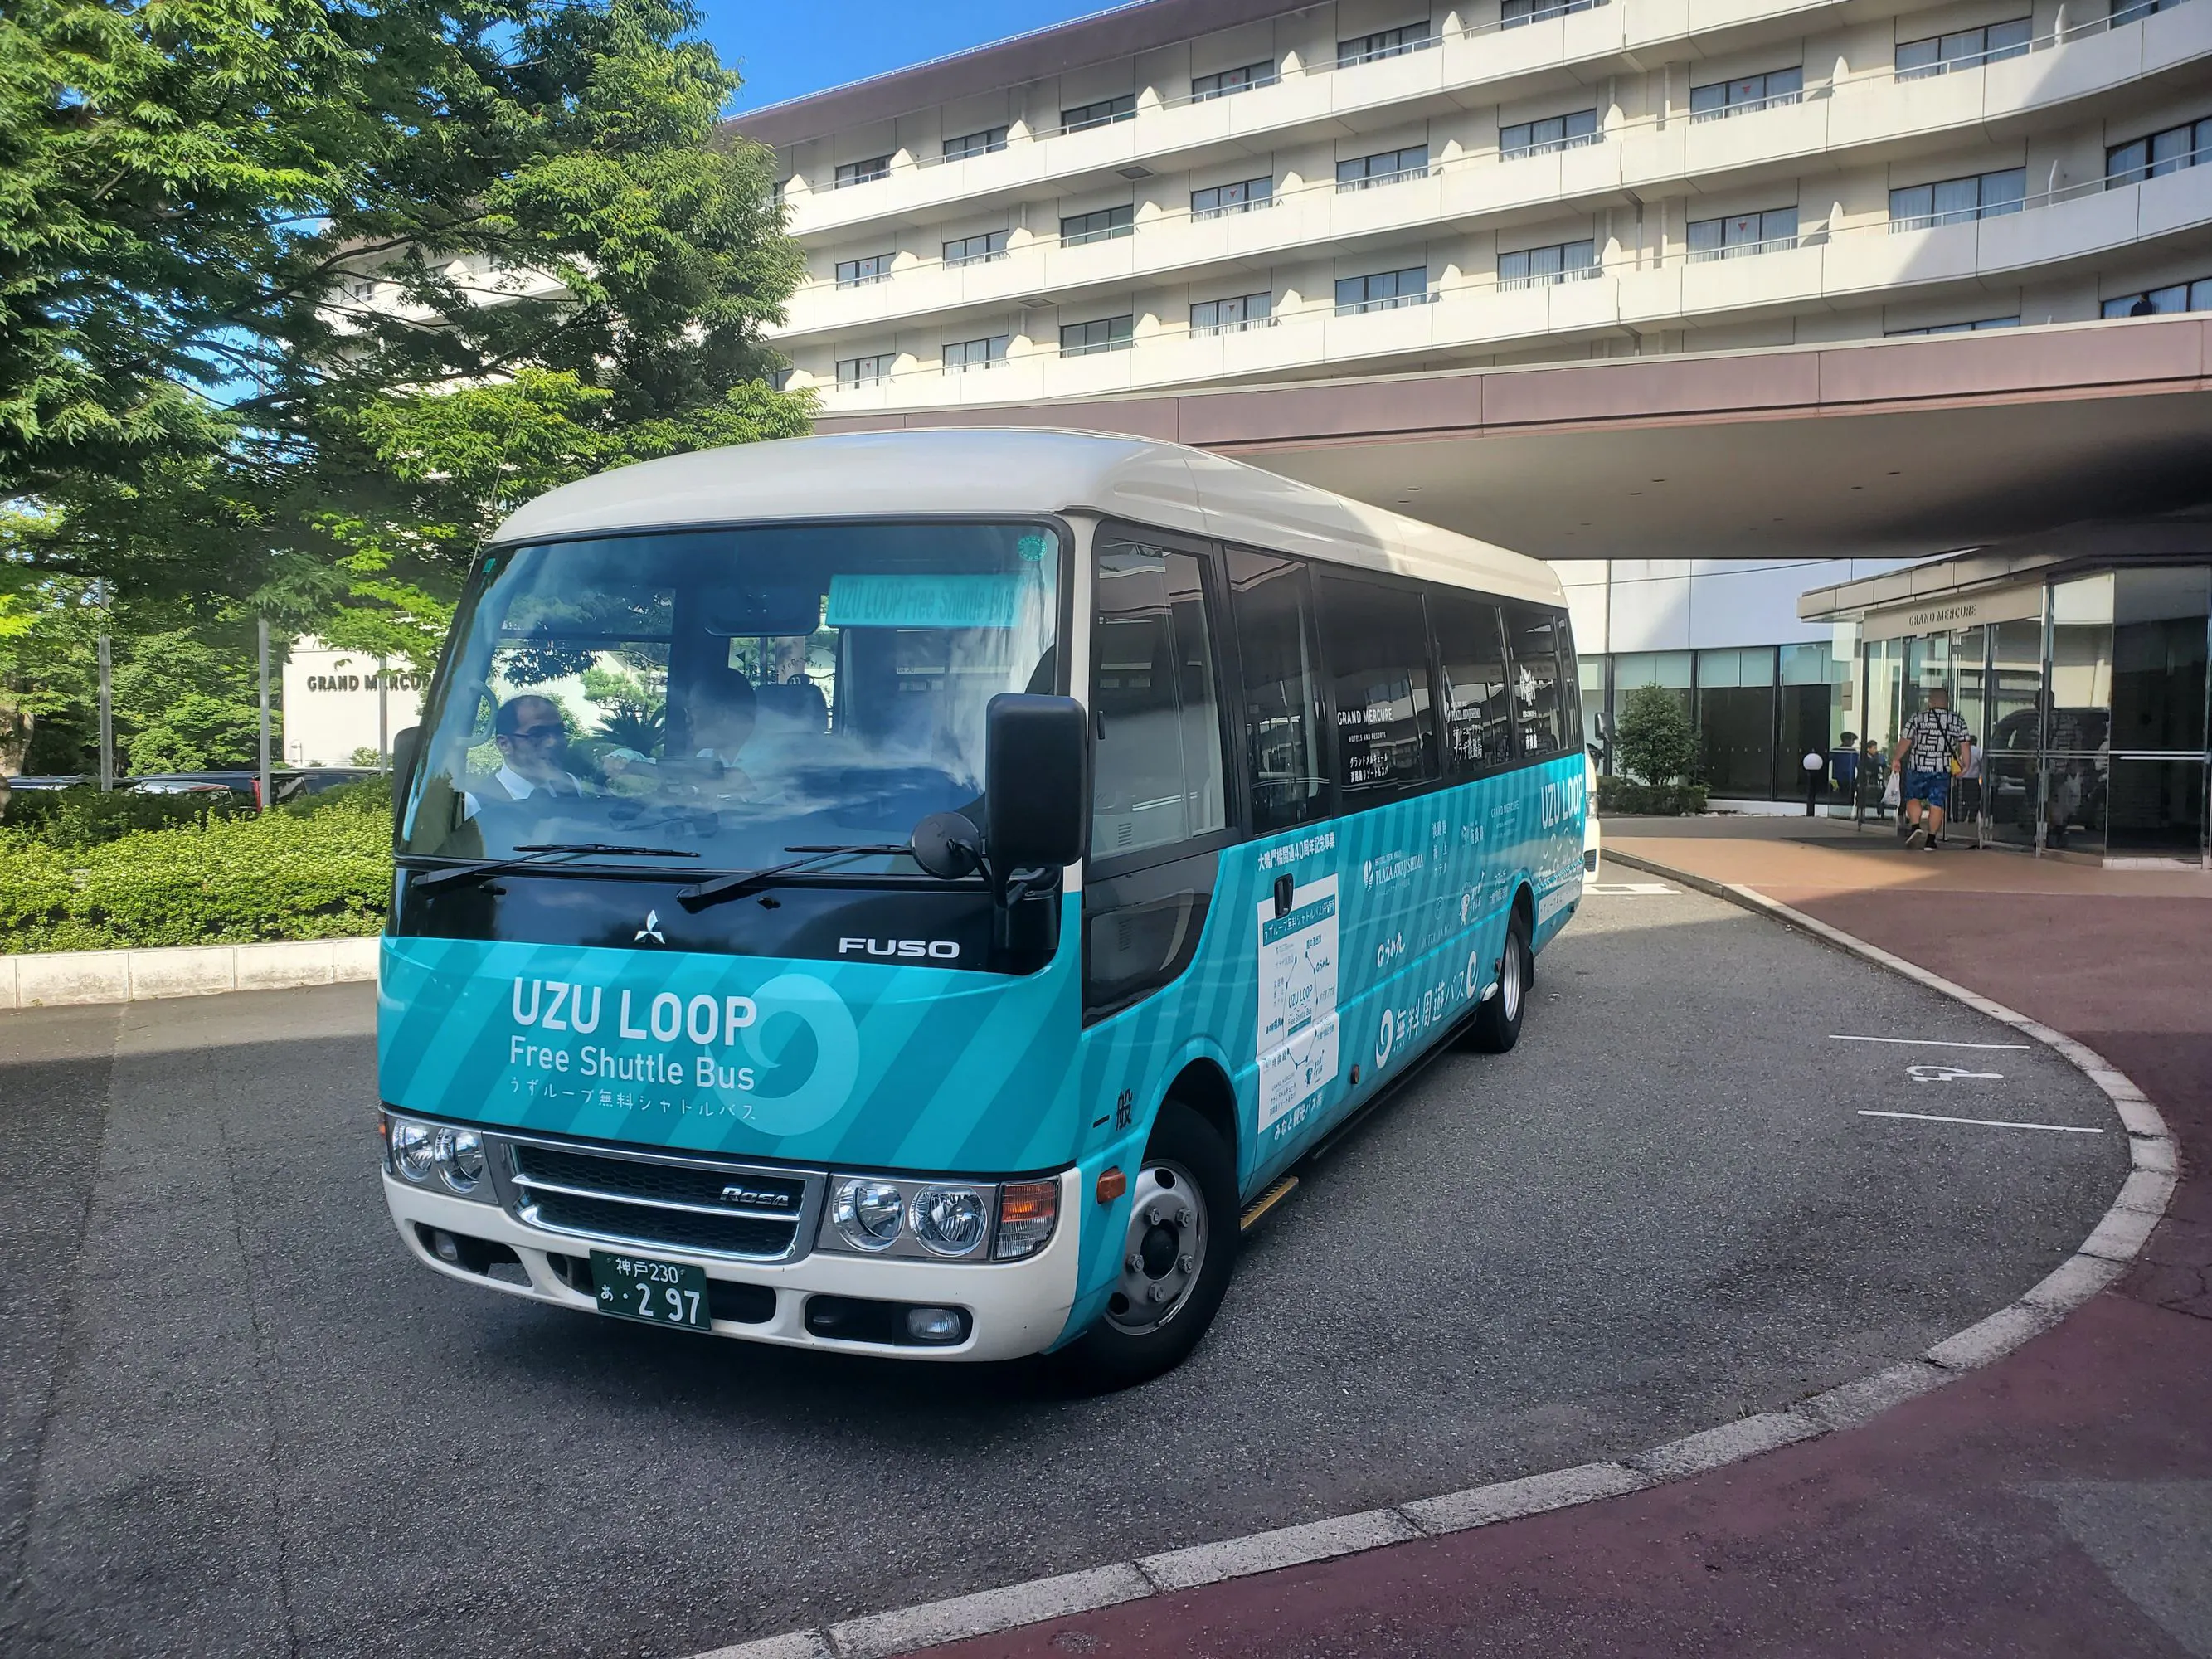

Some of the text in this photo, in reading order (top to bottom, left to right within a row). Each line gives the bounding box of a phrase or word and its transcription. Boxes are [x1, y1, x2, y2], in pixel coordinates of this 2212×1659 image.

[864, 580, 904, 620] LOOP
[904, 585, 936, 620] Free
[1909, 604, 1977, 626] GRAND MERCURE
[307, 675, 359, 692] GRAND
[1337, 708, 1393, 726] GRAND MERCURE
[1348, 734, 1363, 743] HOTELS
[1540, 772, 1583, 830] UZU LOOP
[1375, 867, 1393, 886] PLAZA
[838, 937, 960, 959] FUSO
[1288, 992, 1300, 1009] UZU
[1300, 984, 1313, 1002] LOOP
[512, 976, 757, 1046] UZU LOOP
[1393, 970, 1465, 1053] 無料周遊バス
[510, 1035, 755, 1090] Free Shuttle Bus
[510, 1077, 756, 1120] うずループ無料シャトルバス
[1092, 1087, 1134, 1131] 一般
[600, 1284, 614, 1301] あ
